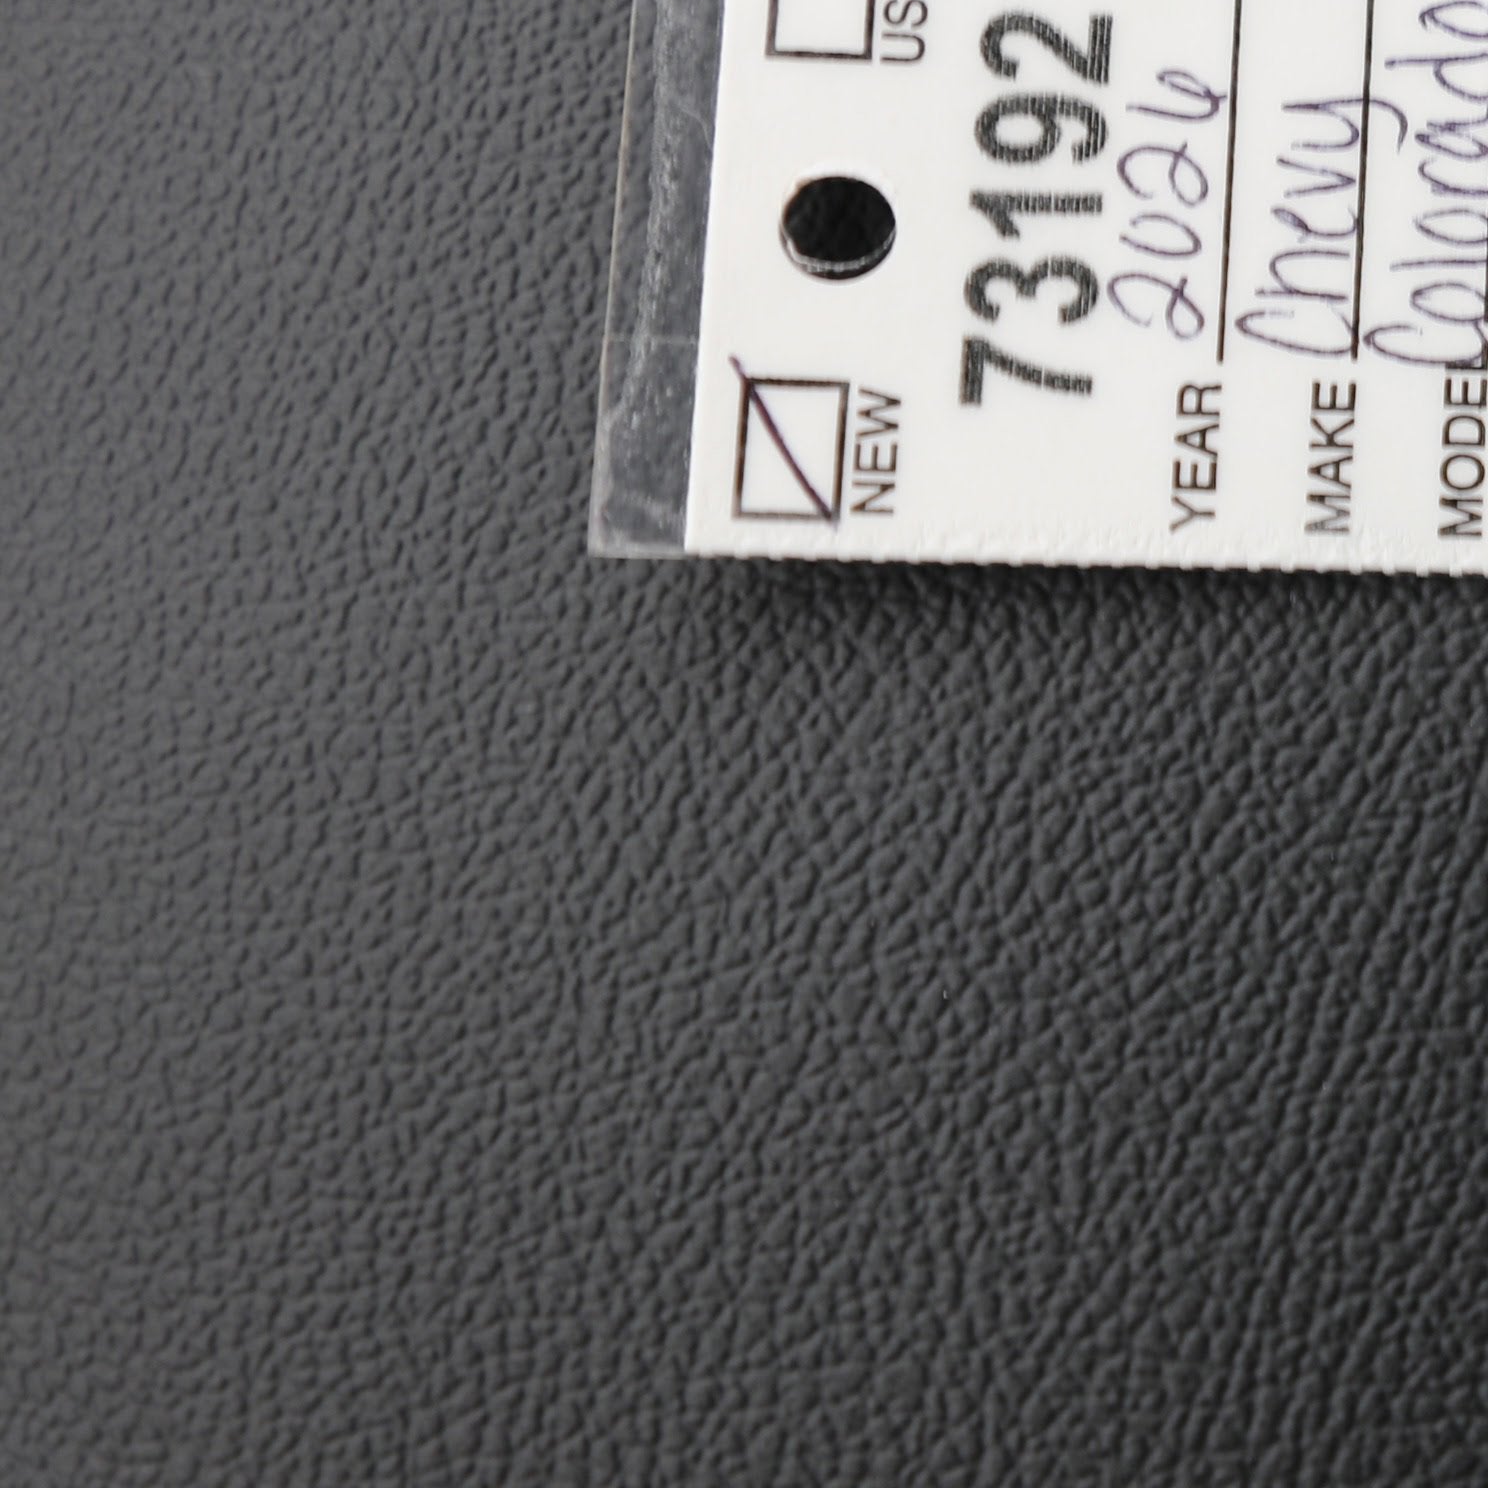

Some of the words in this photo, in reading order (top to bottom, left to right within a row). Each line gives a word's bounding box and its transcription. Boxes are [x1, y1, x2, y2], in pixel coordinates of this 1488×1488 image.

[959, 9, 1114, 408] 73192
[1106, 68, 1228, 341] 2026
[1235, 95, 1408, 357] Chevy
[850, 385, 902, 515] NEW
[1170, 382, 1224, 533] YEAR
[1304, 378, 1357, 536] MAKE
